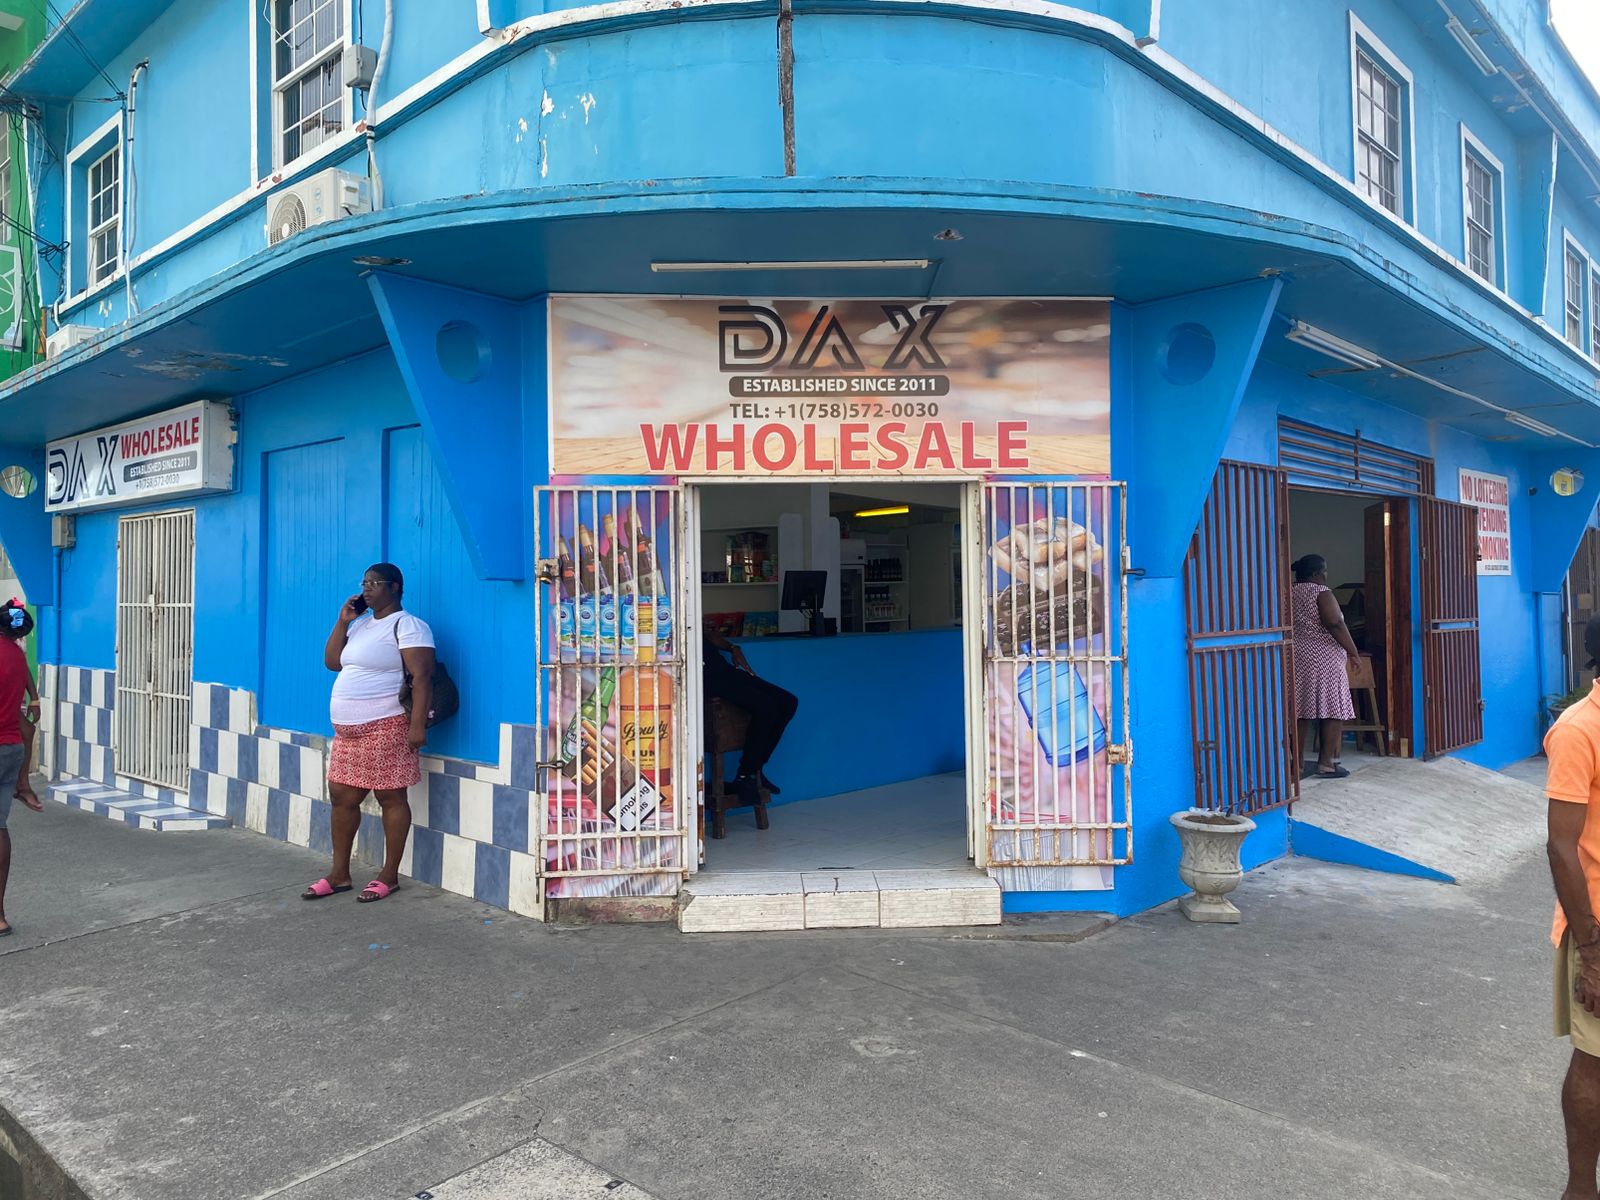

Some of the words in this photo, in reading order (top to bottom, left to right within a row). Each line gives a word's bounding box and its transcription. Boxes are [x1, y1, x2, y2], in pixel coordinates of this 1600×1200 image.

[719, 305, 949, 372] DAX
[743, 379, 847, 392] ESTABLISHED
[850, 378, 896, 392] SINCE
[899, 378, 936, 391] 2011
[729, 403, 770, 418] TEL:
[774, 403, 939, 420] +1(758)572-0030
[120, 416, 200, 459] WHOLESALE
[639, 421, 1030, 471] WHOLESALE
[48, 434, 120, 505] DAX
[129, 461, 162, 478] ESTABLISHED
[161, 457, 178, 472] SINCE
[177, 455, 191, 469] 2011
[1461, 475, 1473, 501] NO
[1474, 477, 1508, 506] LOITERING
